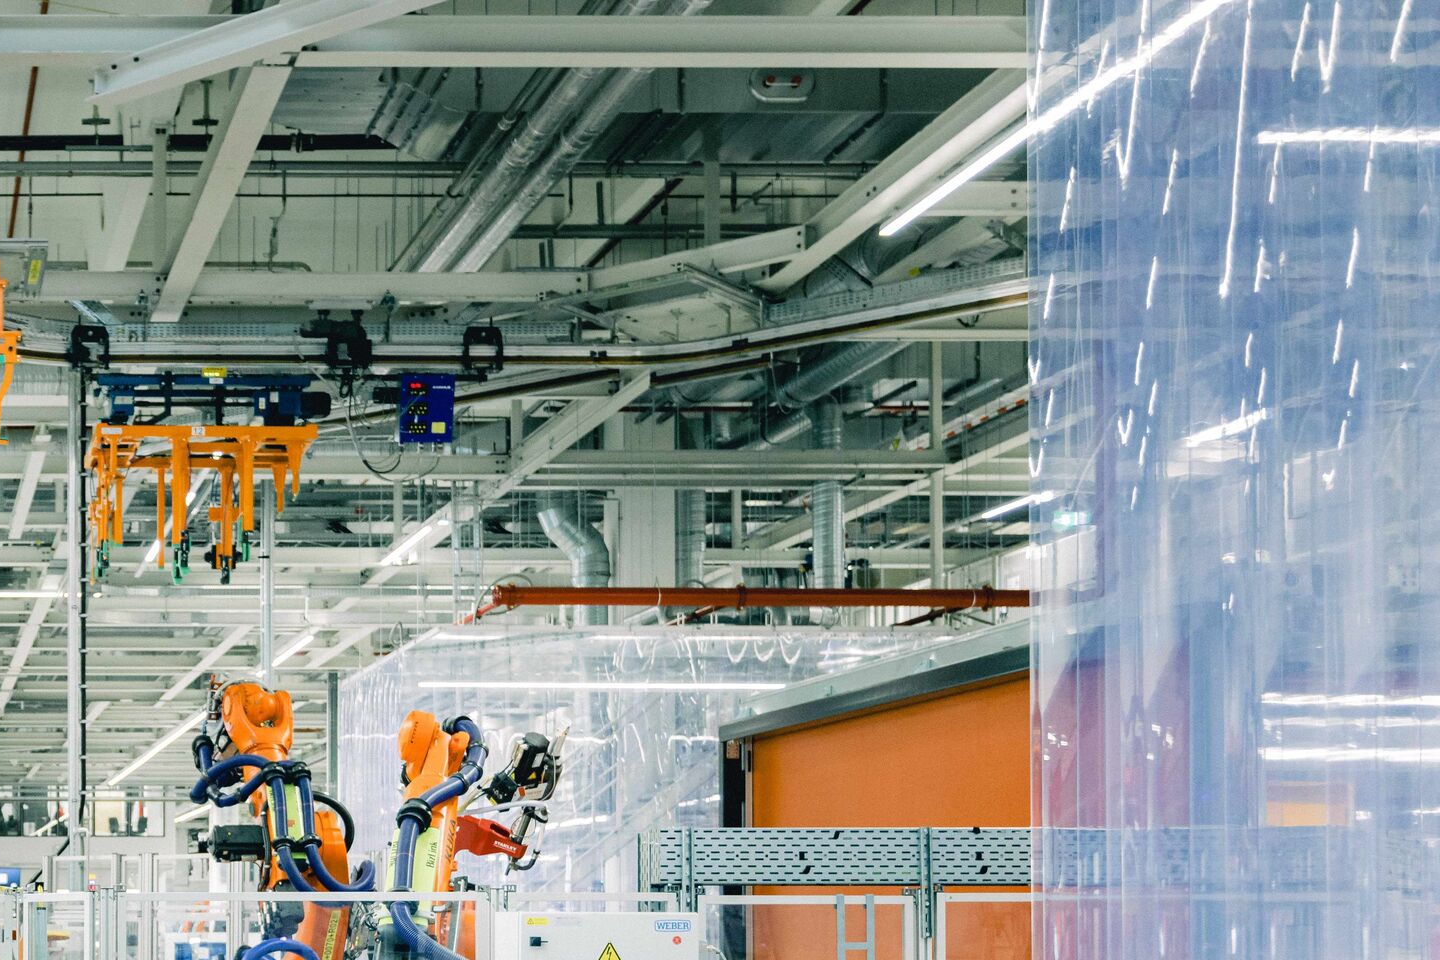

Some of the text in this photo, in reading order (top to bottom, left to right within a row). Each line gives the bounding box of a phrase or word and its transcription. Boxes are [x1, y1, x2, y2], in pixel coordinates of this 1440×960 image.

[445, 819, 457, 864] KUKA
[494, 840, 517, 852] STANLEY
[426, 841, 438, 868] BizLink
[657, 922, 689, 930] WEBER
